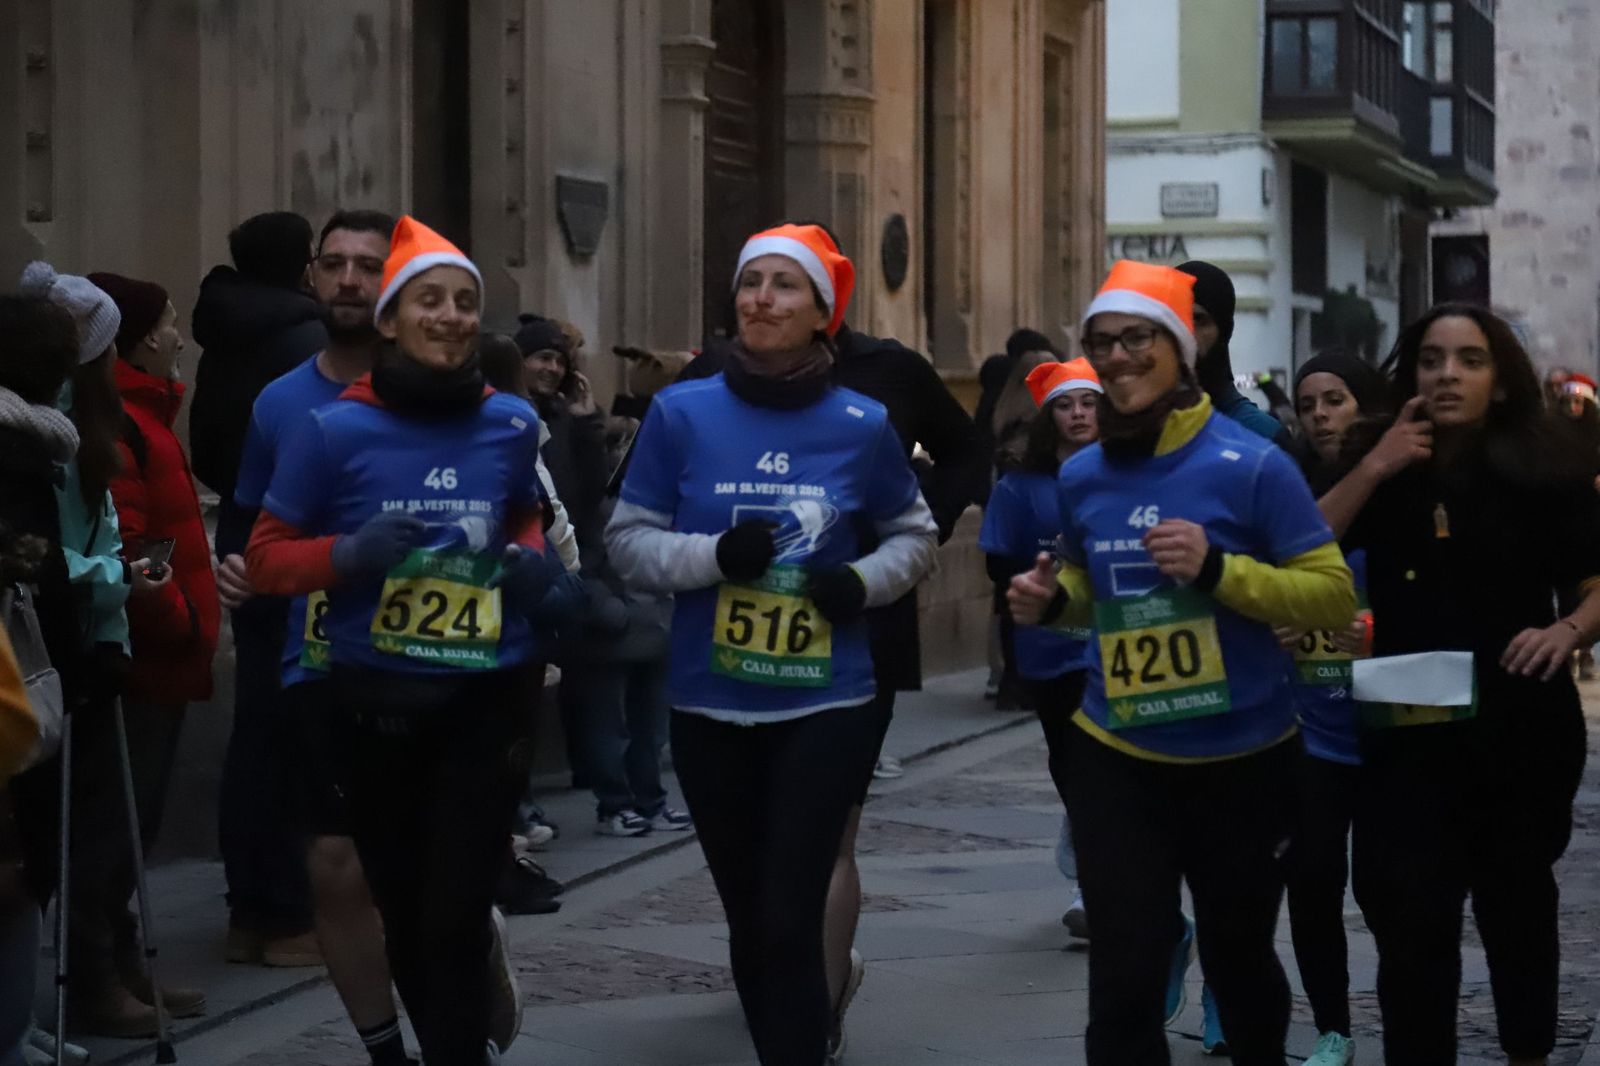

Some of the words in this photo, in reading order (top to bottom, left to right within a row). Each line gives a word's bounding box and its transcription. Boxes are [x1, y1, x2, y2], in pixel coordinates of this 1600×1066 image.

[755, 451, 790, 475] 46
[423, 467, 459, 490] 46
[714, 482, 737, 495] SAN
[739, 482, 797, 496] SILVESTRE
[381, 500, 404, 512] SAN
[407, 500, 467, 512] SILVESTRE
[1127, 504, 1160, 529] 46
[381, 589, 481, 639] 524
[726, 600, 812, 654] 516
[405, 645, 441, 657] CAJA
[443, 647, 490, 661] RURAL
[1111, 629, 1200, 686] 420
[741, 659, 778, 674] CAJA
[779, 664, 824, 678] RURAL
[1137, 699, 1170, 717] CAJA
[1172, 692, 1224, 711] RURAL
